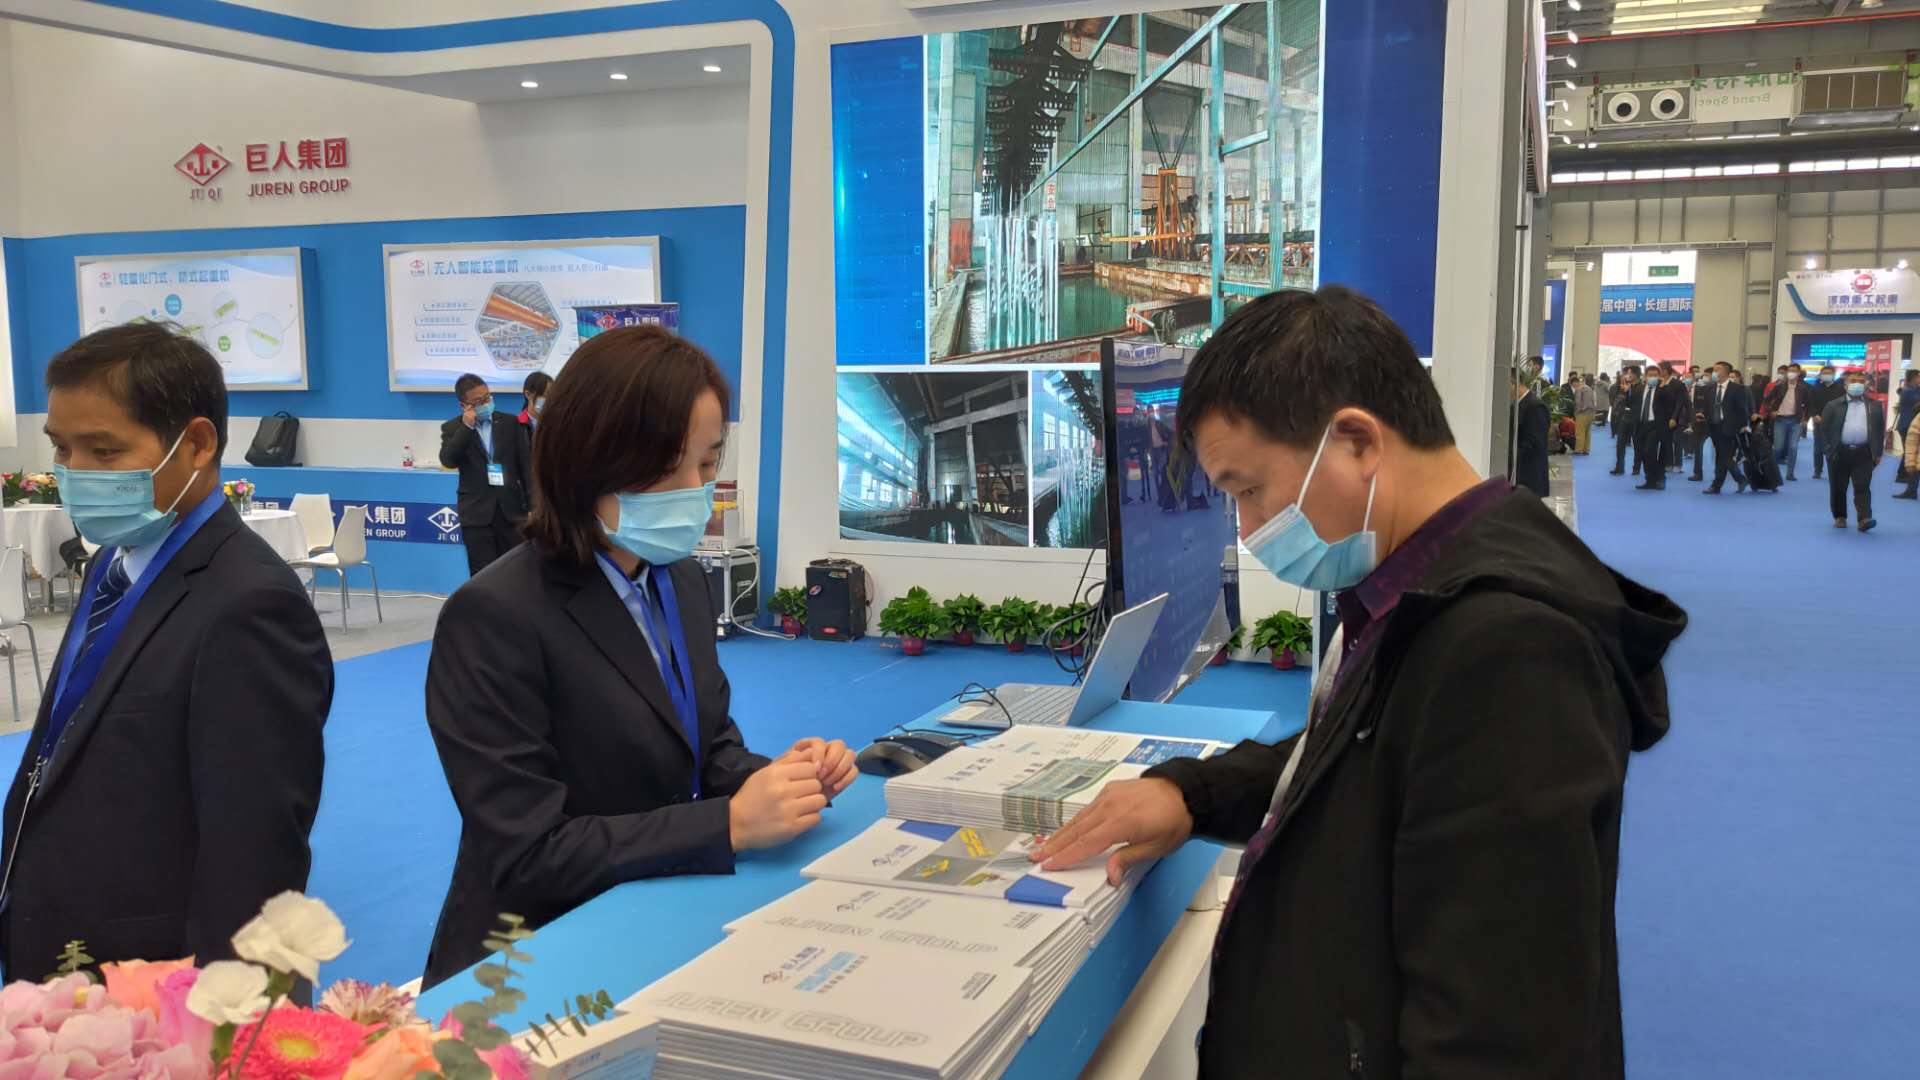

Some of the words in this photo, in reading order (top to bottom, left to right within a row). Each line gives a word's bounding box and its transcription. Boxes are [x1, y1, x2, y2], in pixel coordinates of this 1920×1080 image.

[246, 137, 348, 172] 巨人集团
[248, 182, 294, 197] JUREN
[299, 178, 350, 193] GROUP
[1600, 297, 1692, 312] 届中国·长垣国际
[375, 528, 407, 538] GROUP
[652, 990, 780, 1024] JUREN
[784, 1009, 930, 1048] GROUP
